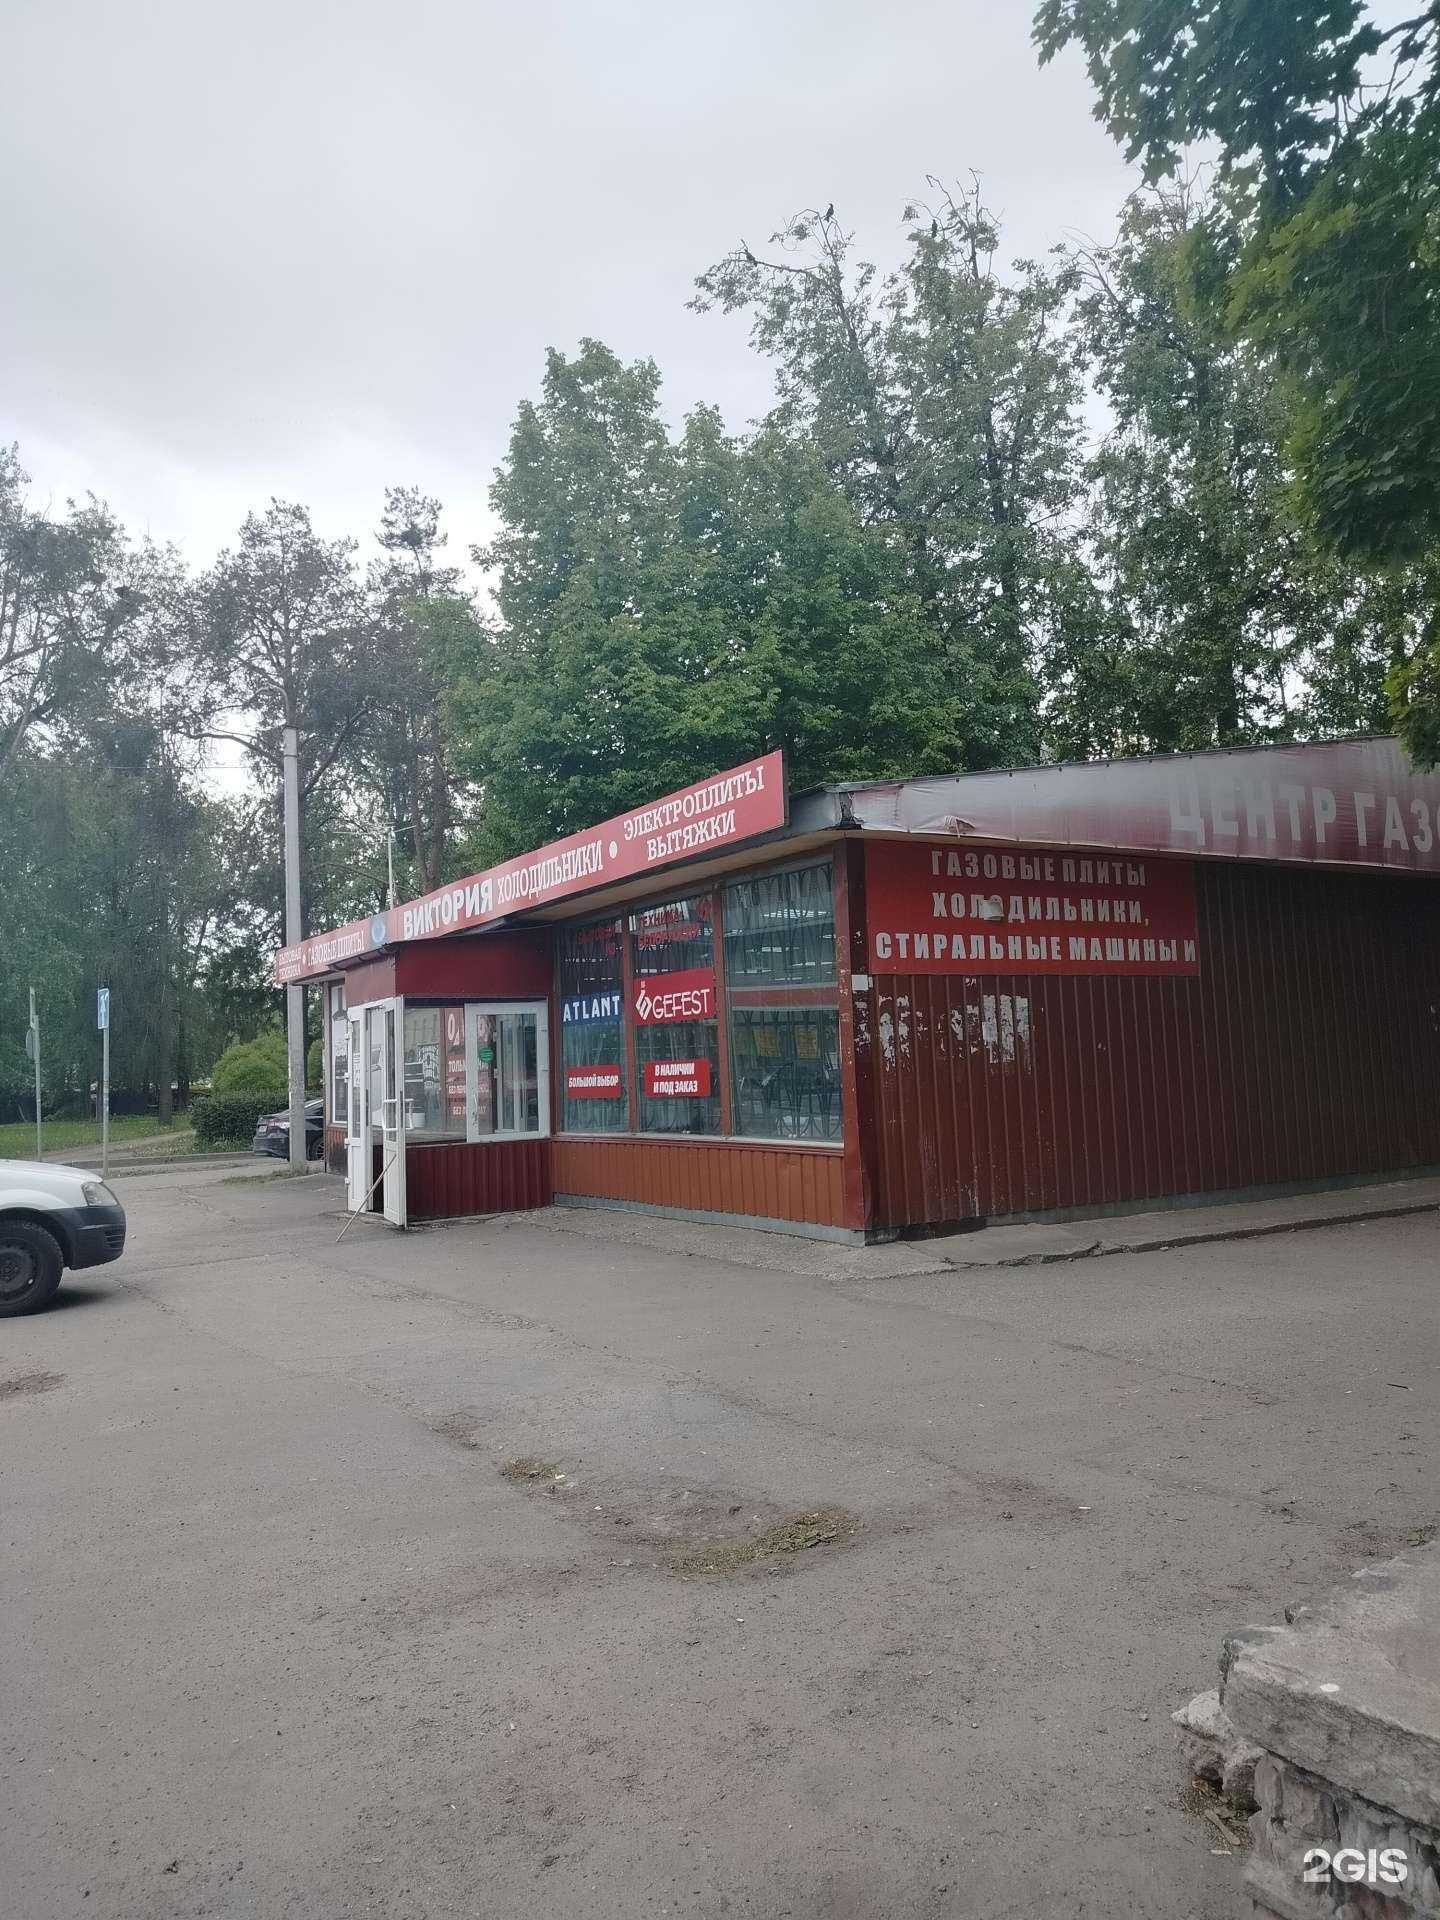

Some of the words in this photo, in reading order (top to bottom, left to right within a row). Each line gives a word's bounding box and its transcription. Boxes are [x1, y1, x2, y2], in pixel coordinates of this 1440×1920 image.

[624, 765, 765, 840] ЭЛЕКТРОПЛИТЫ
[1168, 774, 1337, 846] ЦЕНТР
[1353, 791, 1440, 853] ГАЗ
[647, 809, 736, 861] ВЫТЯЖКИ
[931, 851, 1055, 881] ГАЗОВЫЕ
[1062, 859, 1146, 886] ПЛИТЫ
[403, 878, 494, 940] ВИКТОРИЯ
[497, 840, 603, 904] ХОЛОДИЛЬНИКИ
[875, 932, 1062, 960] СТИРАЛЬНЫЕ
[1068, 936, 1178, 961] МАШИНЫ
[1183, 939, 1196, 961] И
[563, 995, 620, 1022] ATLANT
[652, 989, 710, 1019] GEFEST
[568, 1074, 597, 1088] БОЛЬШОЙ
[597, 1075, 619, 1087] ВЫБОР
[655, 1064, 660, 1076] В
[661, 1063, 695, 1076] НАЛИЧИИ
[653, 1082, 659, 1093] И
[660, 1082, 674, 1095] ПОД
[675, 1080, 698, 1093] ЗАКАЗ
